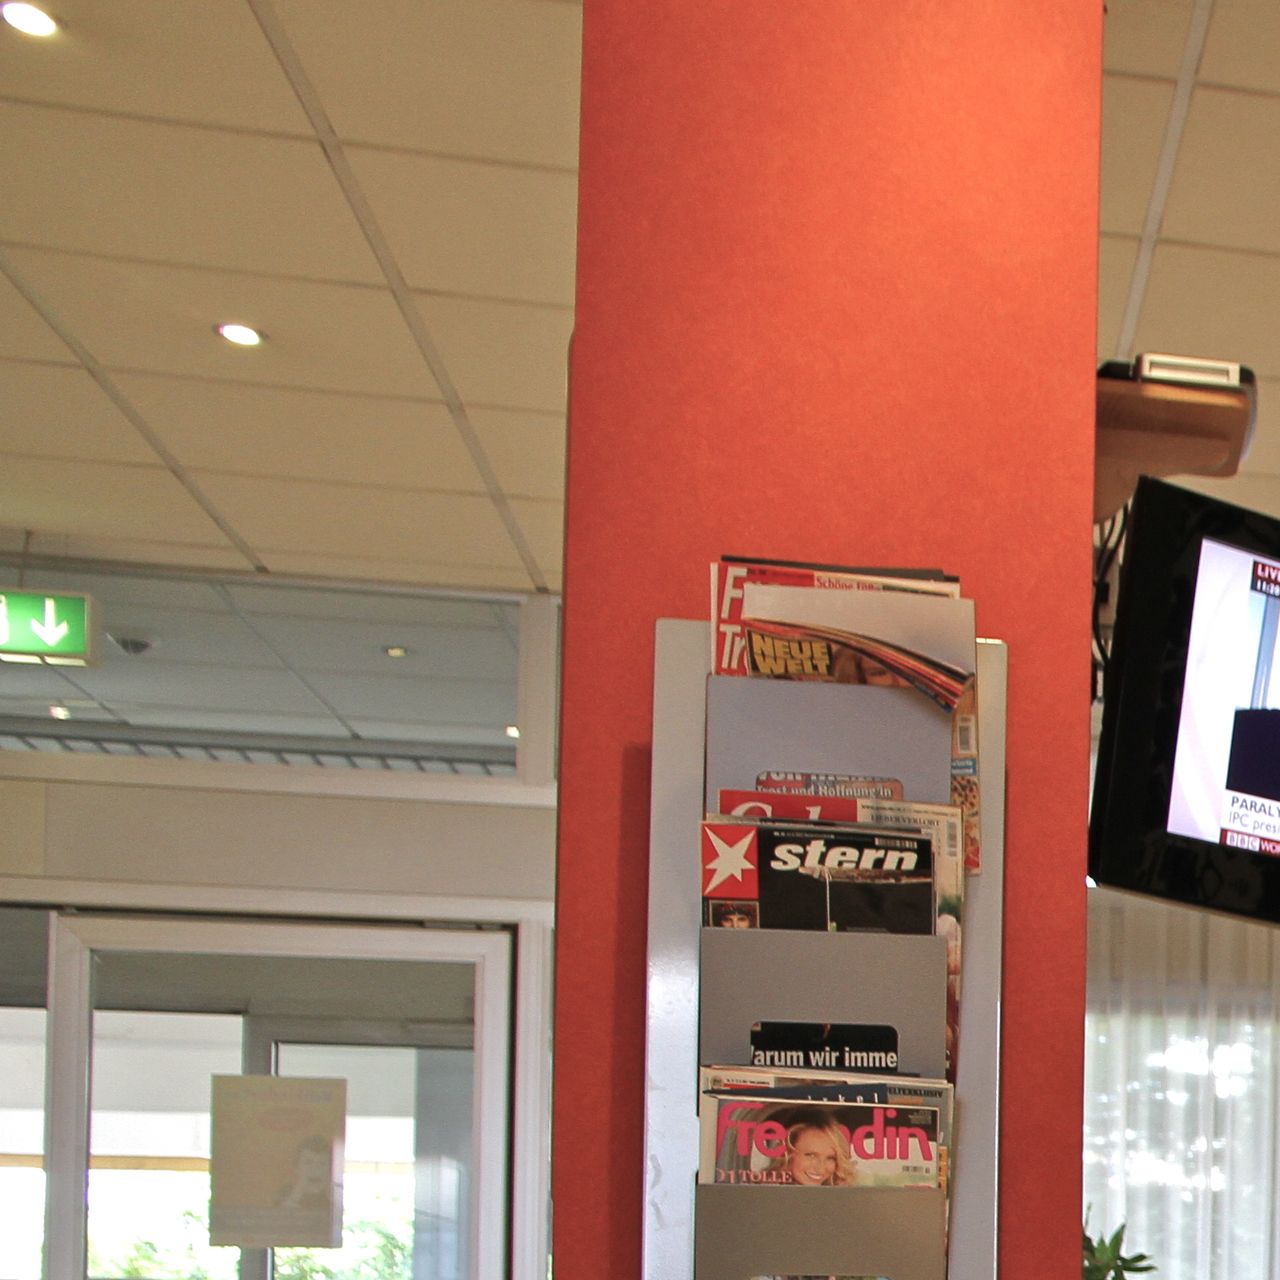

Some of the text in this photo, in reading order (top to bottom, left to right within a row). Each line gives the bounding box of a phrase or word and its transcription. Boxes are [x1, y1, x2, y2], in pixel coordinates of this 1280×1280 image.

[721, 566, 747, 619] F
[720, 624, 745, 670] Tr
[752, 632, 829, 659] NEUE
[753, 655, 830, 676] WELT
[1229, 811, 1249, 828] IPC
[1226, 830, 1260, 851] BBC
[770, 839, 918, 871] stern
[809, 1046, 839, 1067] wir
[717, 1102, 933, 1162] fredin
[738, 1168, 793, 1184] TOLLE
